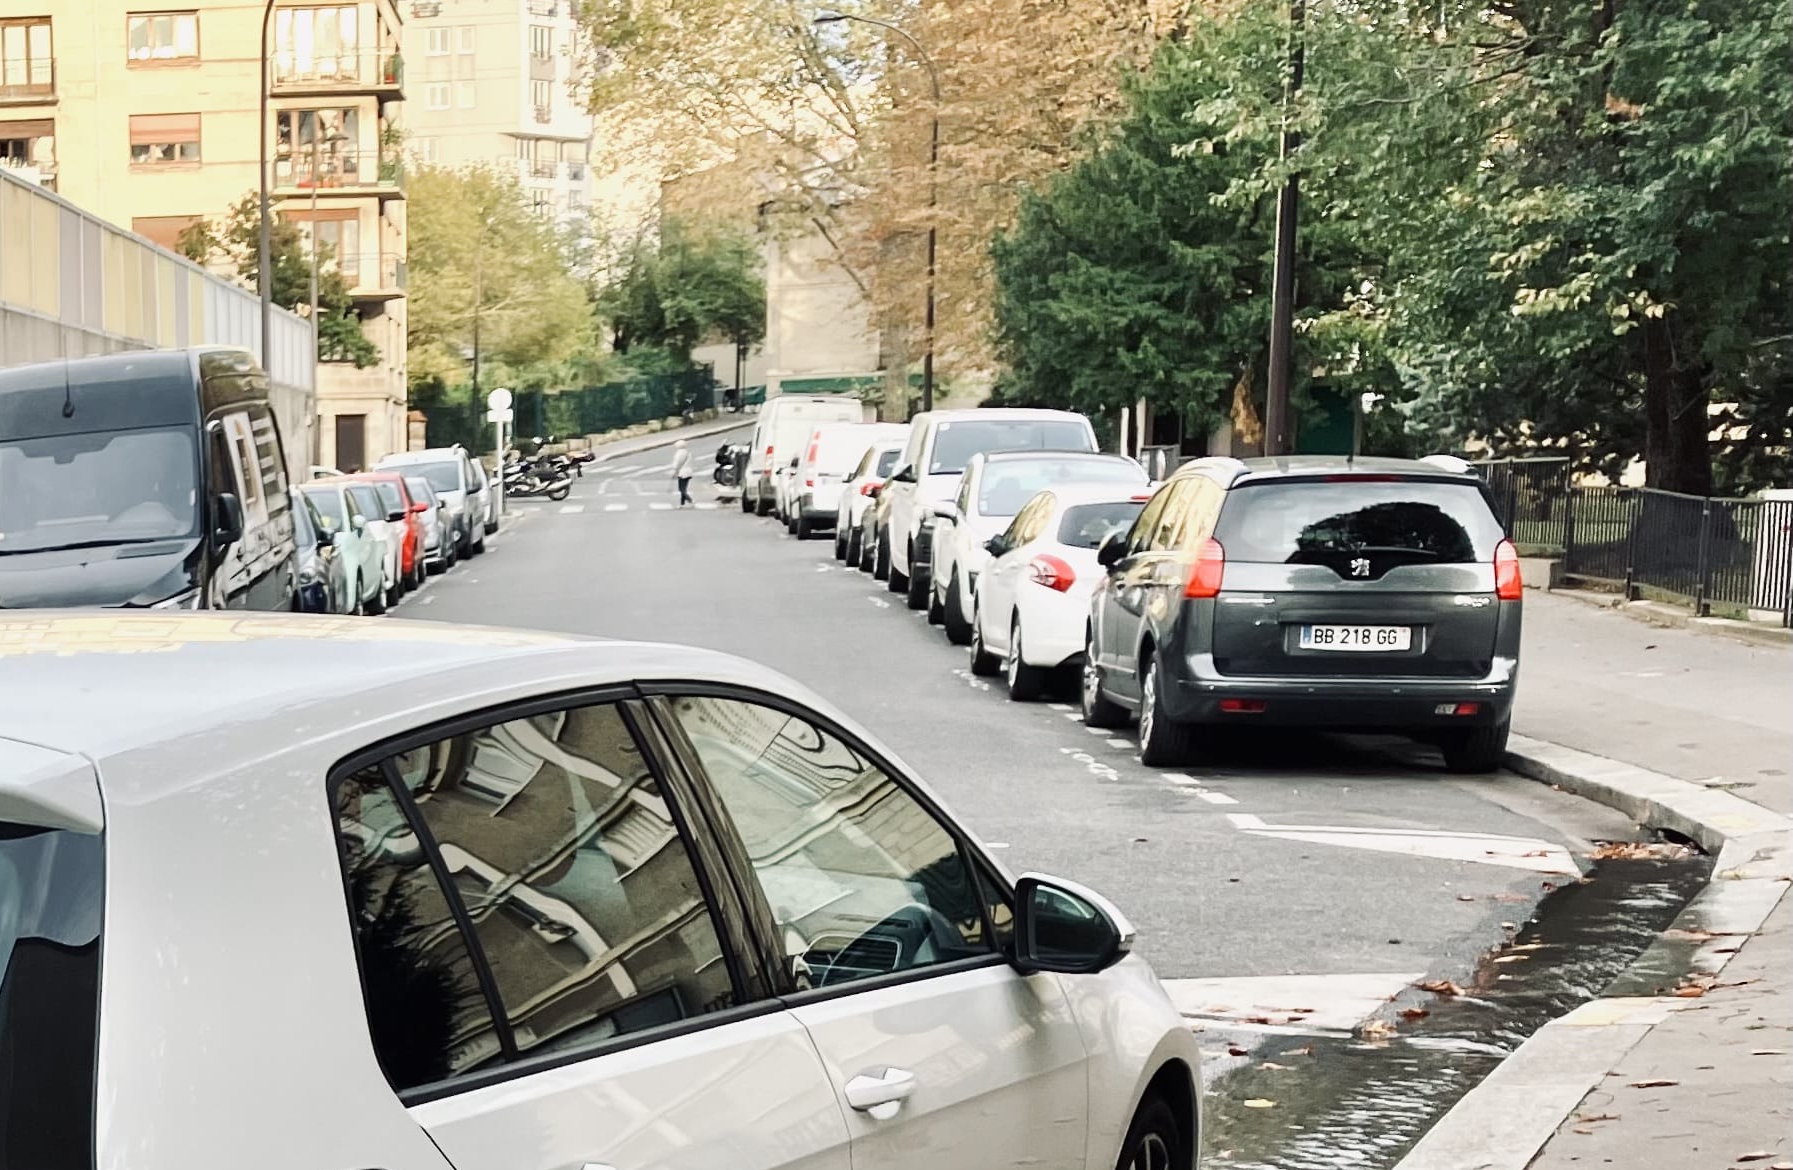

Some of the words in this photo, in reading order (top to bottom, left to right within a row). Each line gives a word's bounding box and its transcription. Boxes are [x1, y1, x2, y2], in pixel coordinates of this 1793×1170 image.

[1314, 628, 1335, 644] BB
[1340, 628, 1371, 645] 218
[1377, 629, 1397, 645] GG
